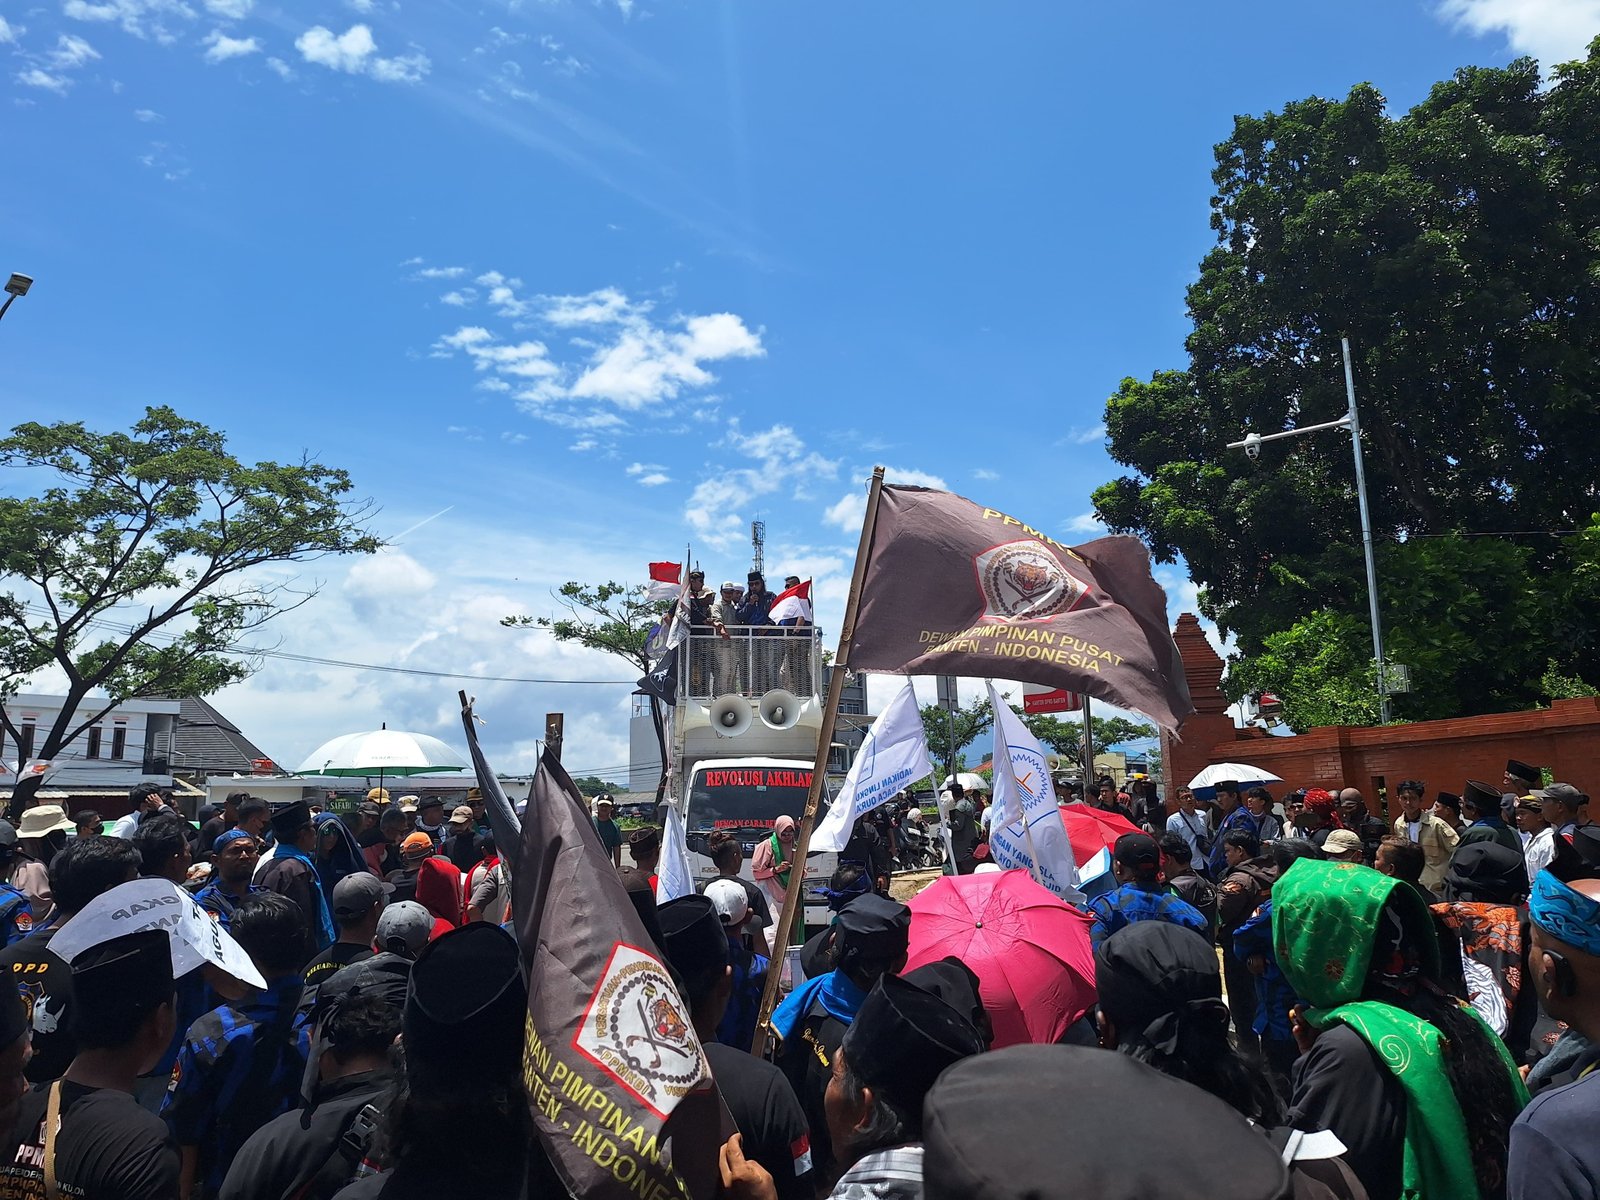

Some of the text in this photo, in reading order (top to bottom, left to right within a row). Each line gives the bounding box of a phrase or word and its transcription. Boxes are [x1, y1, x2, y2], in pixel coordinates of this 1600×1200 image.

[919, 625, 1124, 667] DEWAN PIMPINAN PUSAT
[994, 642, 1101, 673] INDONESIA
[706, 771, 763, 787] REVOLUSI
[1012, 847, 1034, 869] YANG
[210, 919, 226, 965] AGU
[600, 1050, 651, 1095] PPMKBI
[550, 1061, 661, 1166] PIMPINAN
[571, 1119, 686, 1200] INDONE
